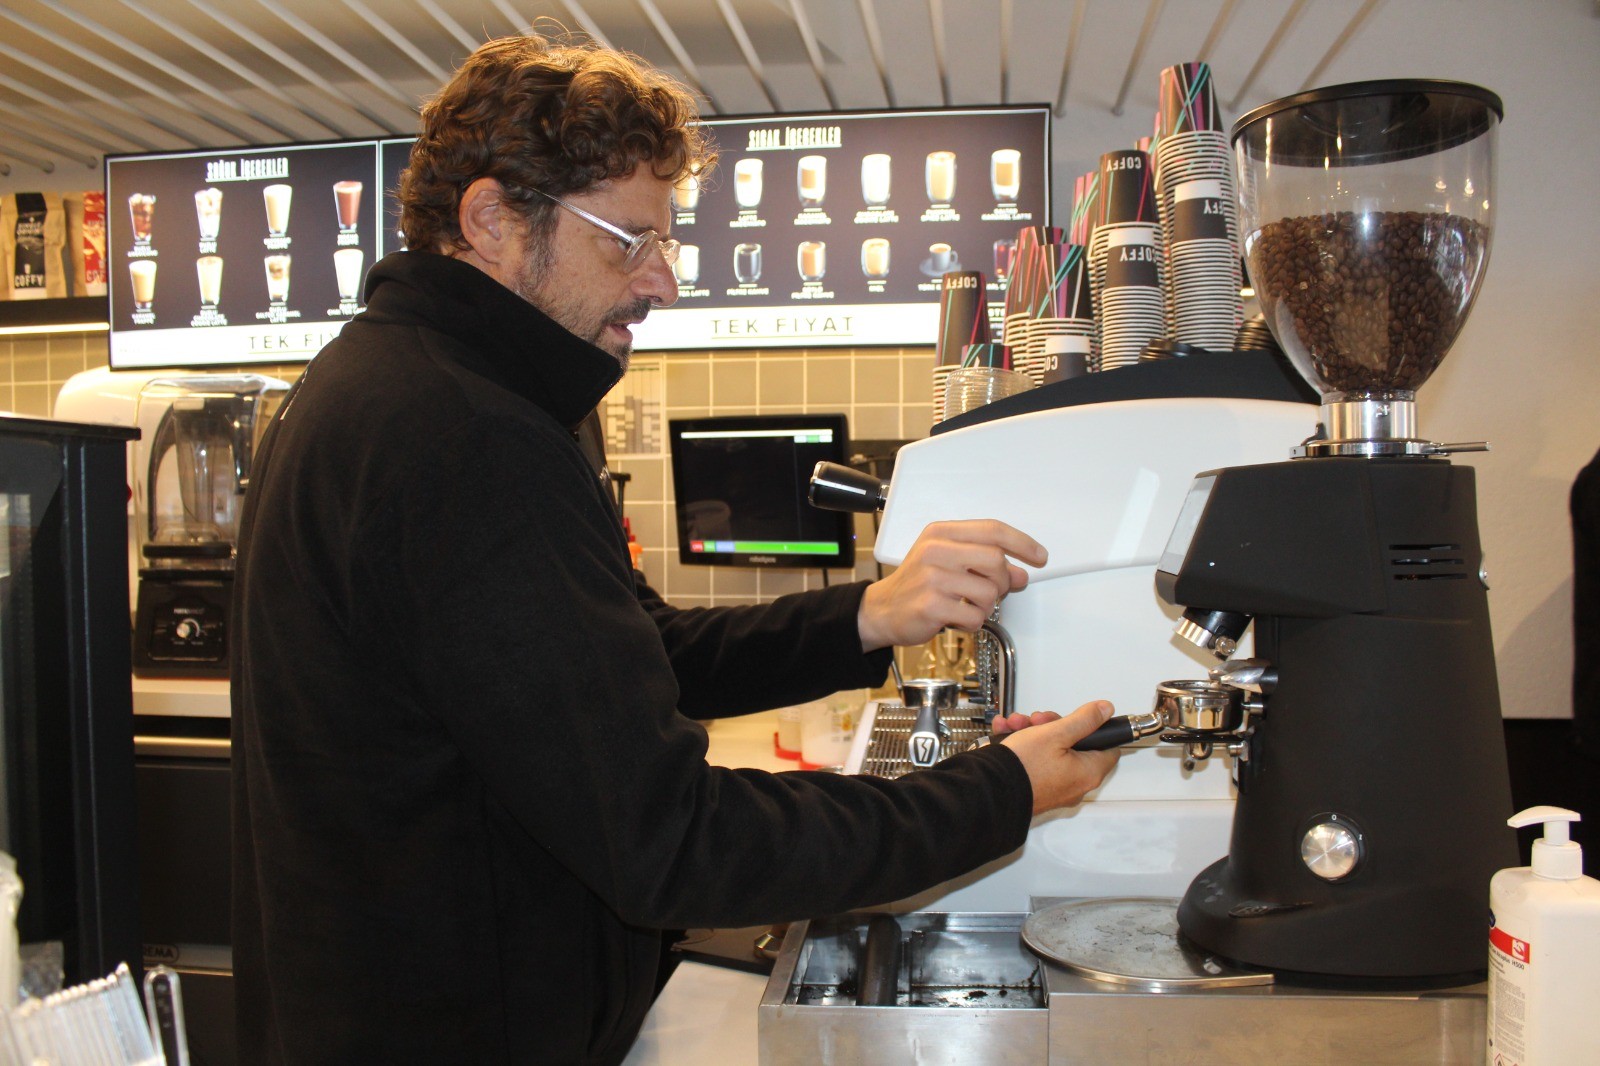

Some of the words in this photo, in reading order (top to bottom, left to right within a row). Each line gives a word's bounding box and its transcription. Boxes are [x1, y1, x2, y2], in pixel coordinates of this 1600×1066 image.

[1106, 157, 1141, 172] COFFY
[946, 276, 977, 290] COFFY
[710, 318, 758, 334] TEK
[776, 316, 853, 333] FIYAT
[248, 335, 289, 350] TEK
